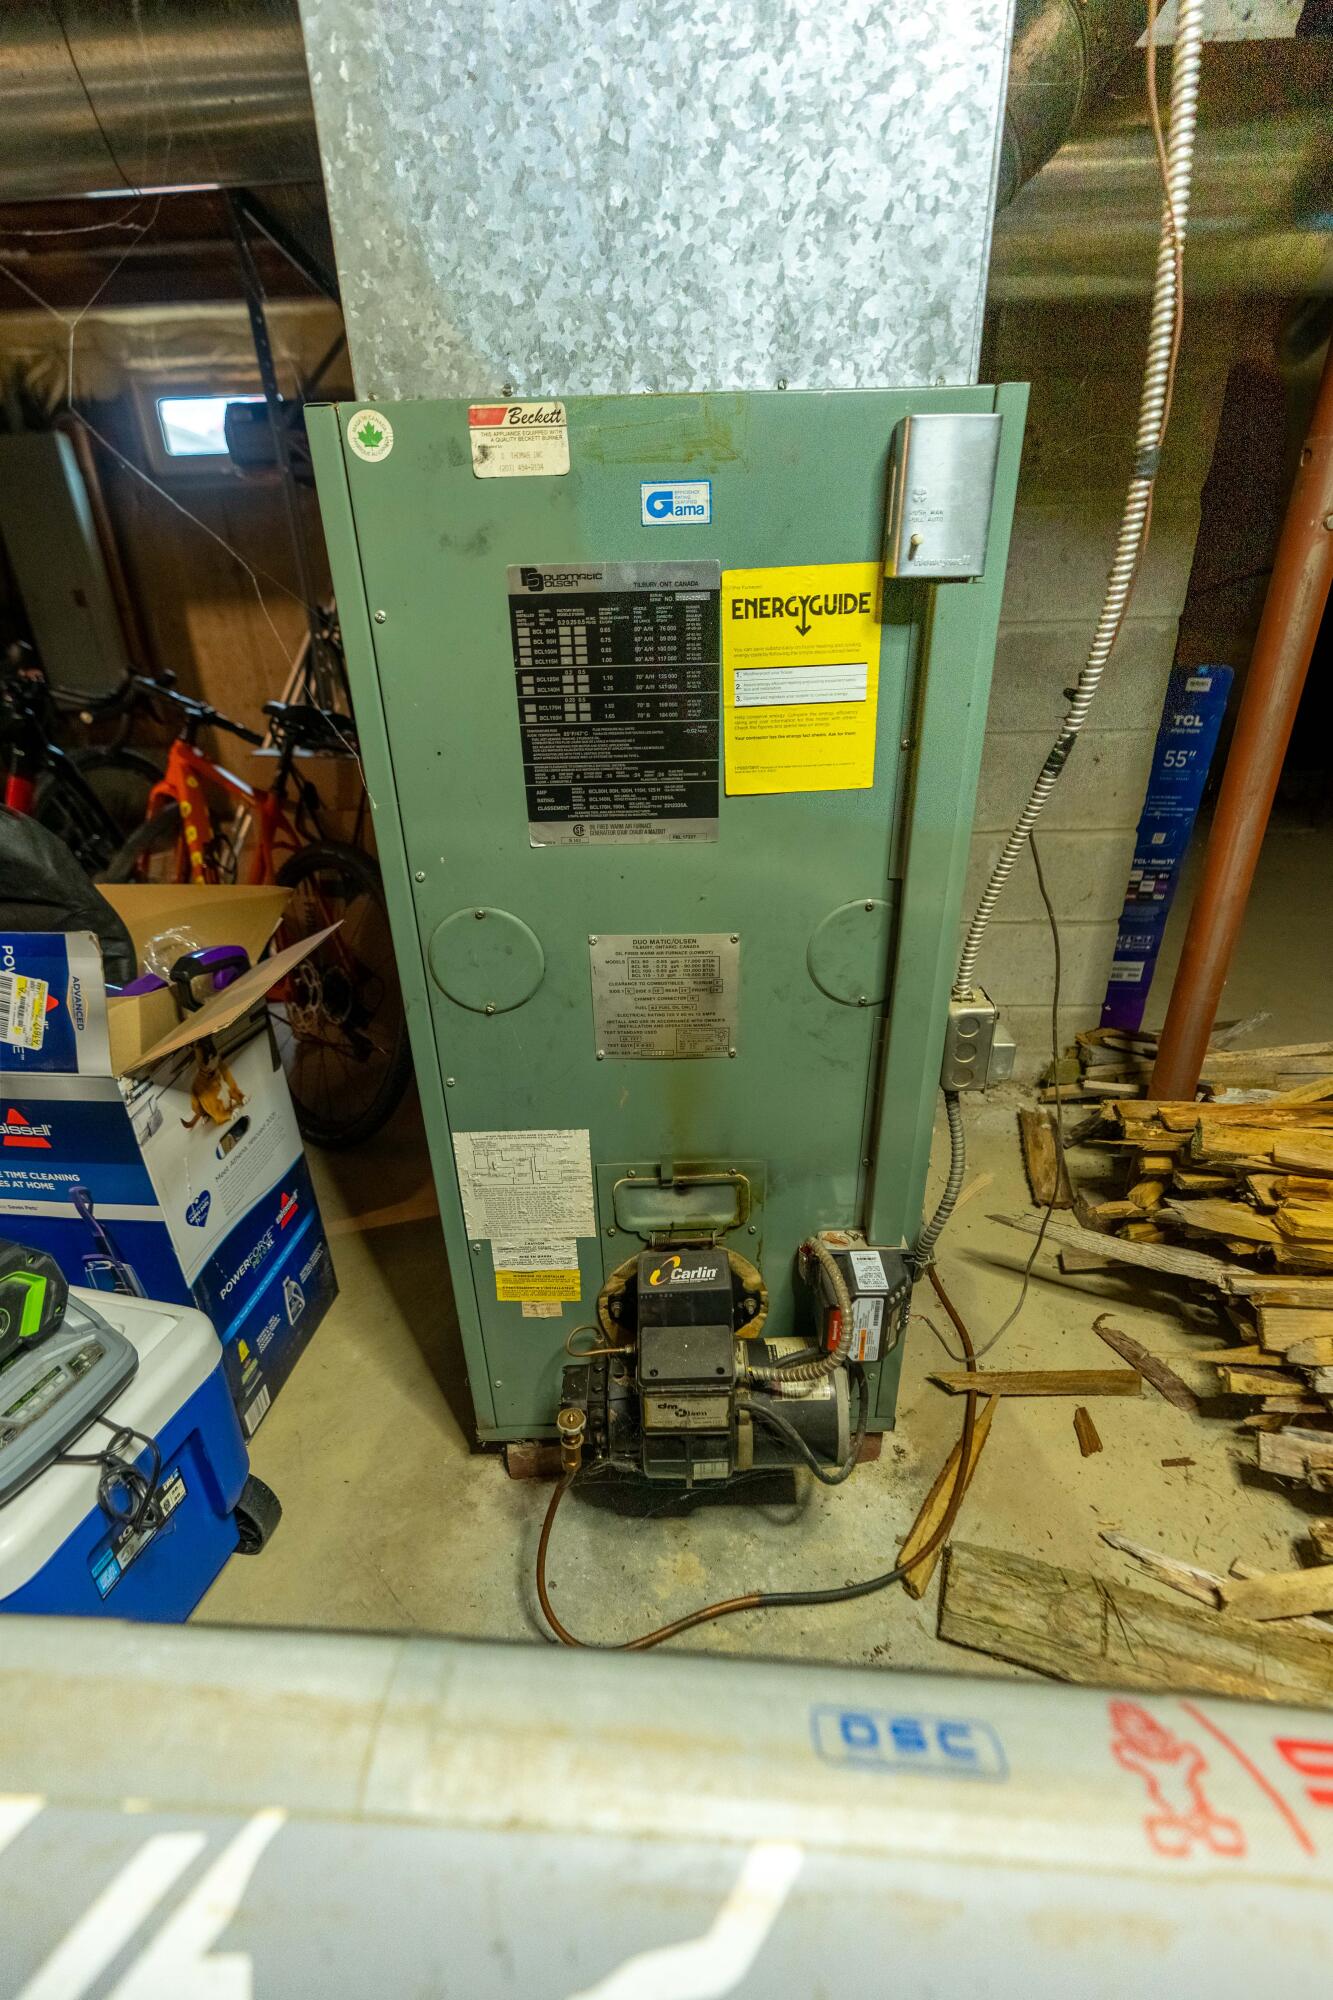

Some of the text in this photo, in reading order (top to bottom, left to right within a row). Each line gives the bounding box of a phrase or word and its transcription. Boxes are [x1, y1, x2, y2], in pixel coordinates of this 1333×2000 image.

[508, 406, 562, 424] Beckett
[732, 592, 872, 620] ENERGYGUIDE
[1173, 715, 1204, 727] TCL
[72, 975, 85, 1031] ADVANCED
[3, 1170, 81, 1183] TIME CLEANING
[221, 1228, 275, 1300] POWERFORCE
[671, 1266, 717, 1280] Carlin
